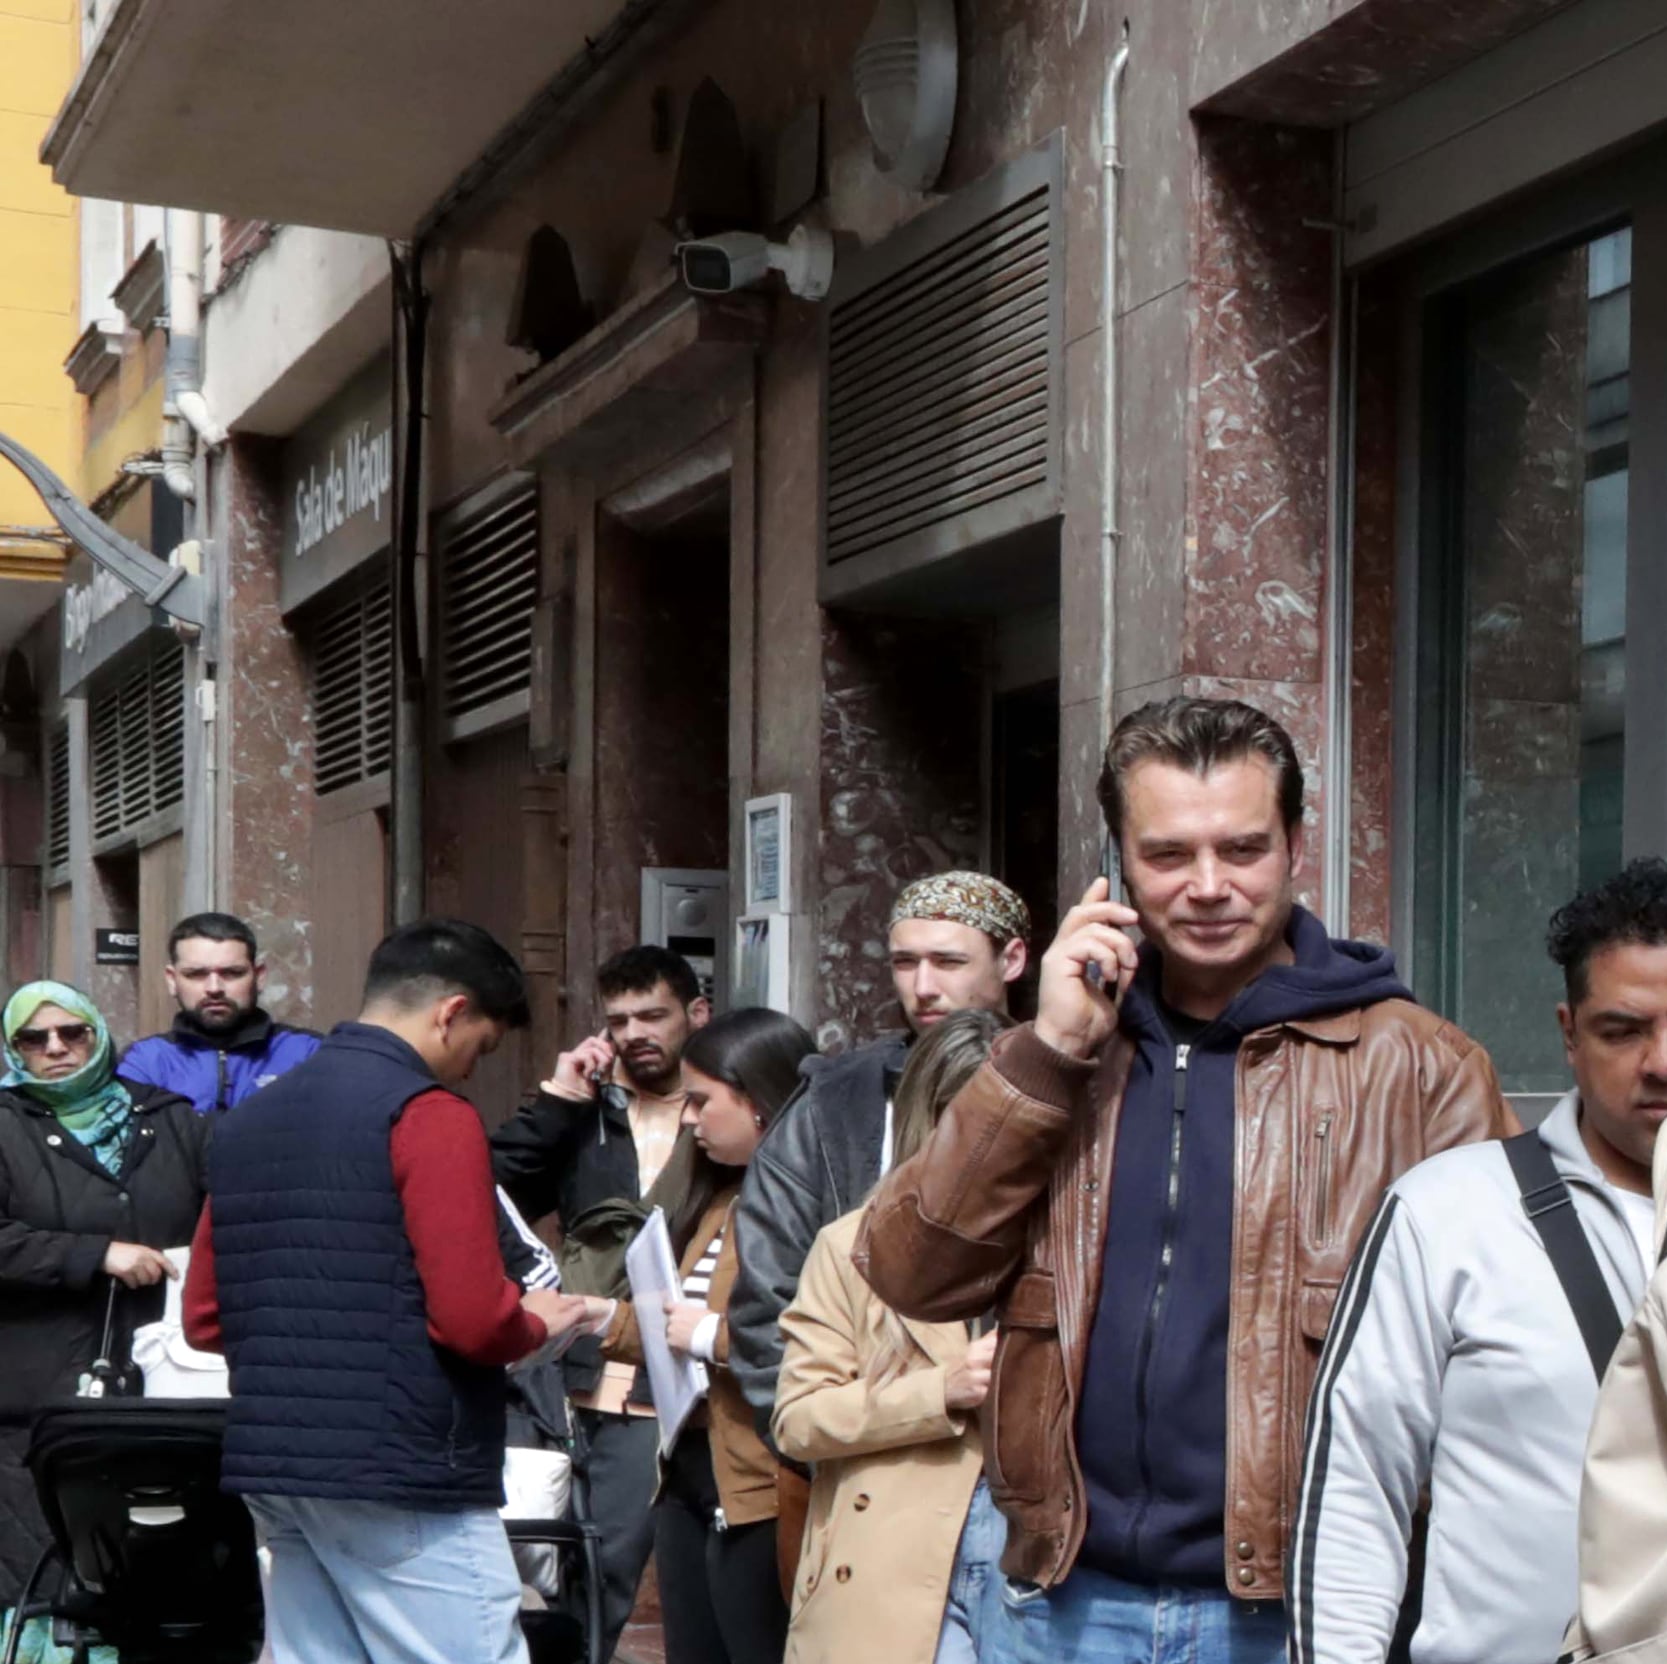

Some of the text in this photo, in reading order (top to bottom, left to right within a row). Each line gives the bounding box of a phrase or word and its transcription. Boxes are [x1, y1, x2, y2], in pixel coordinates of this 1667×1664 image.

[296, 421, 392, 556] Sala de Máqu
